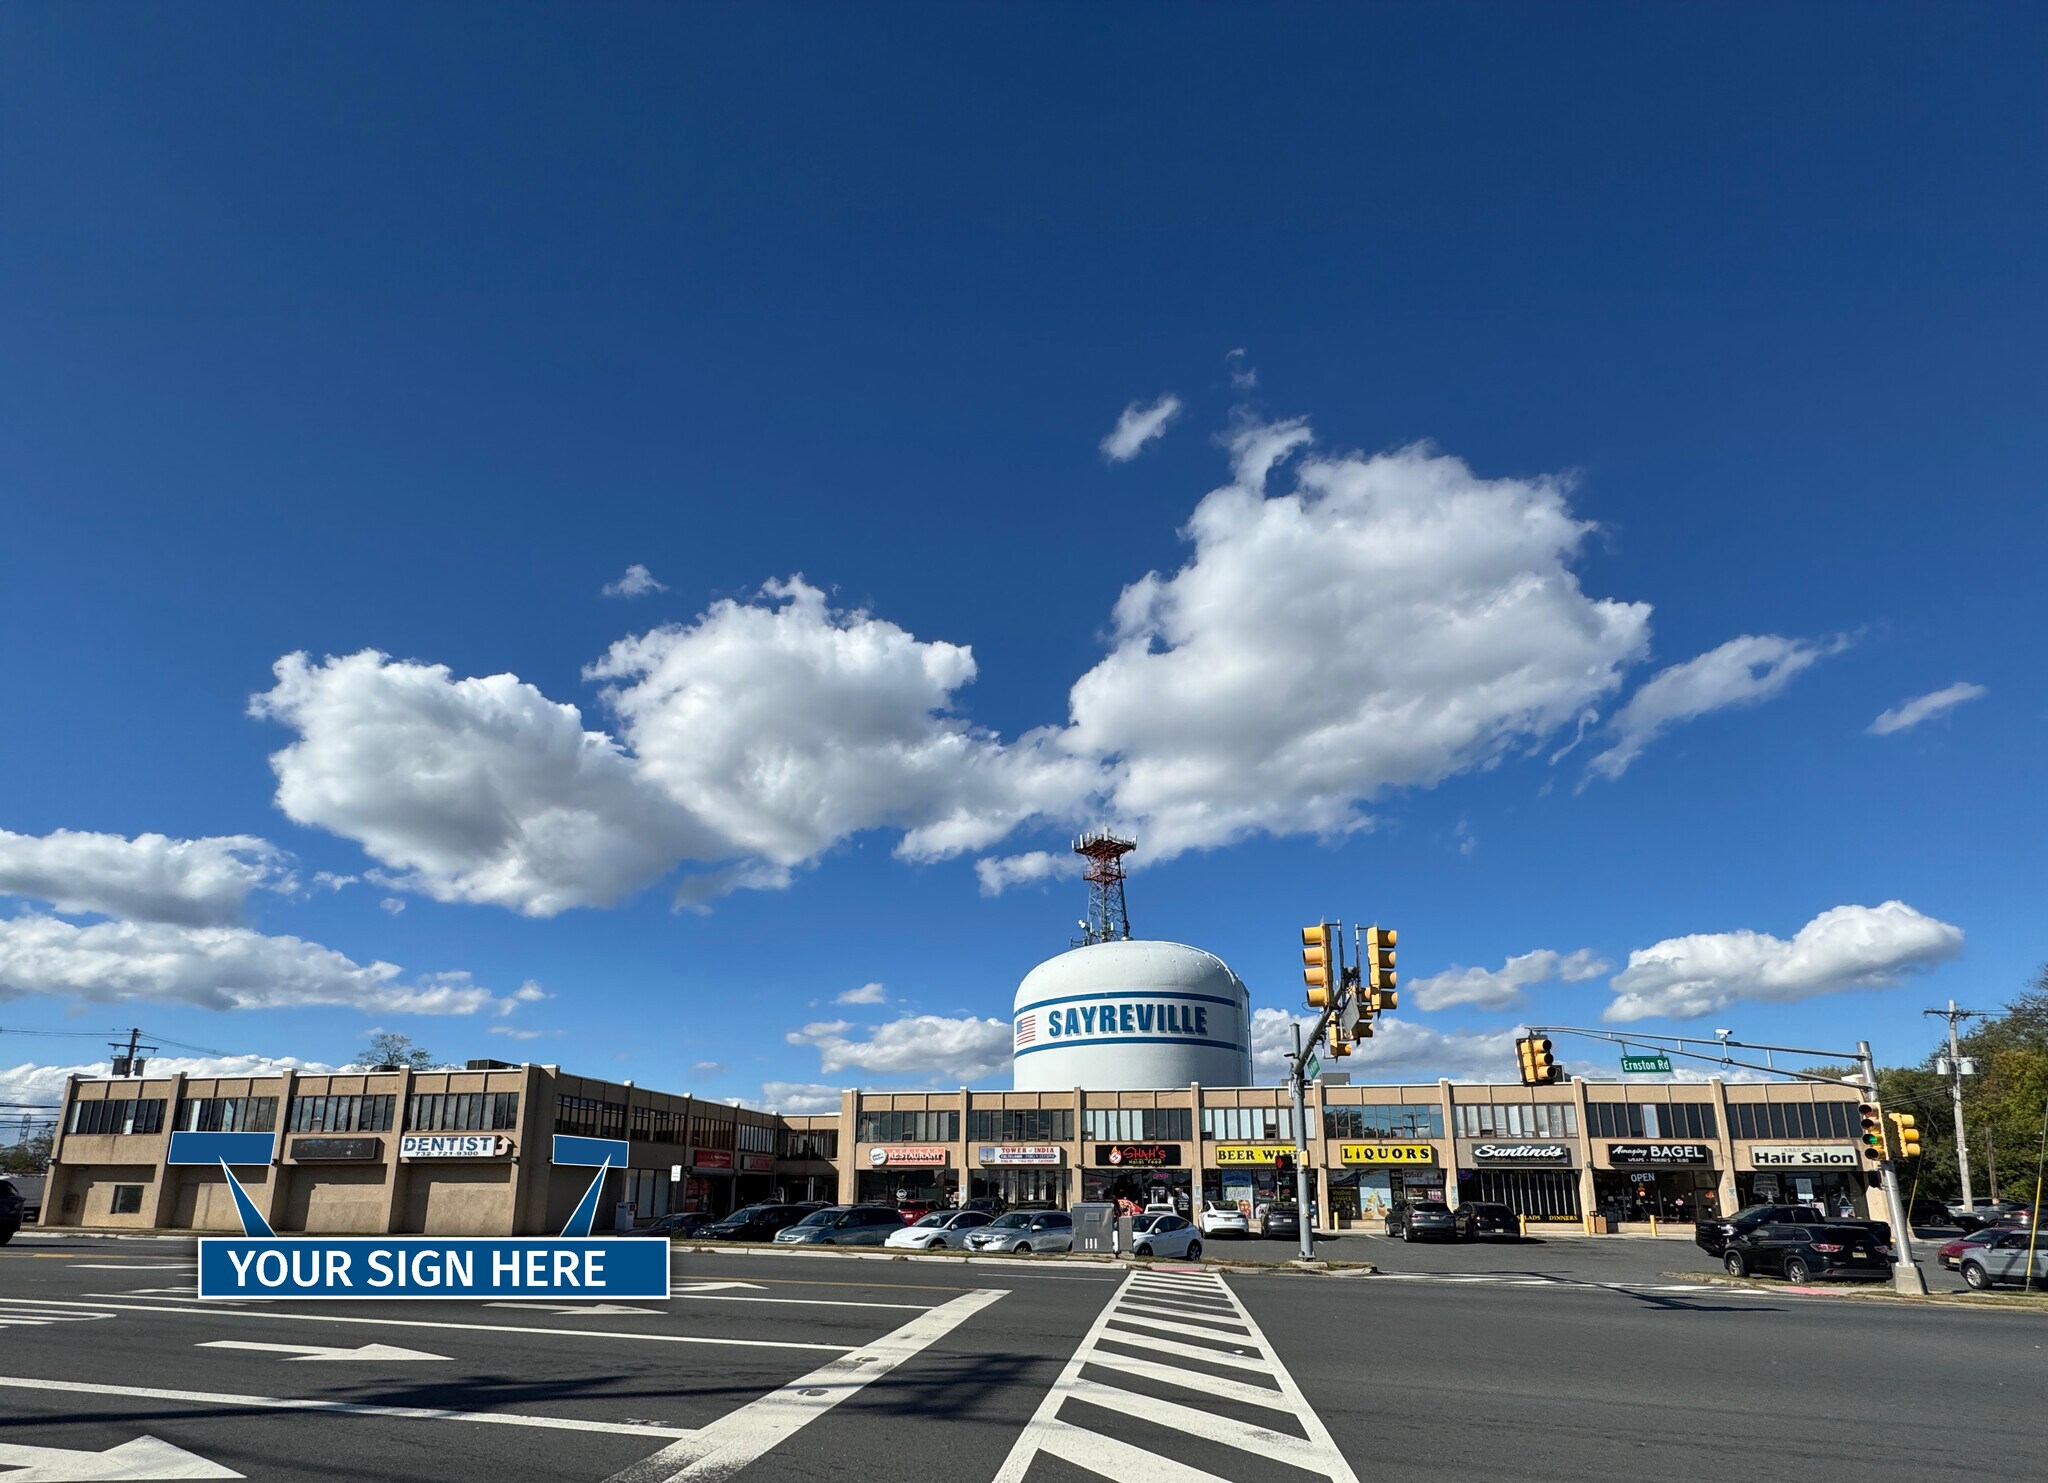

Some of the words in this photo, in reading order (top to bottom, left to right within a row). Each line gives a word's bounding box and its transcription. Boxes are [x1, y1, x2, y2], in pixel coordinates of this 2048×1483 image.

[1048, 1004, 1208, 1038] SAYREVILLE
[1622, 1059, 1657, 1071] Ernston
[1657, 1059, 1670, 1070] Rd
[403, 1137, 492, 1152] DENTIST
[1218, 1150, 1255, 1160] BEER
[1343, 1148, 1430, 1160] LIQUORS
[1474, 1145, 1564, 1157] Santino's
[1612, 1145, 1648, 1156] Amazing
[1650, 1145, 1704, 1157] BAGEL
[1754, 1152, 1795, 1163] Hair
[1801, 1152, 1854, 1163] Salon
[1630, 1172, 1655, 1182] OPEN
